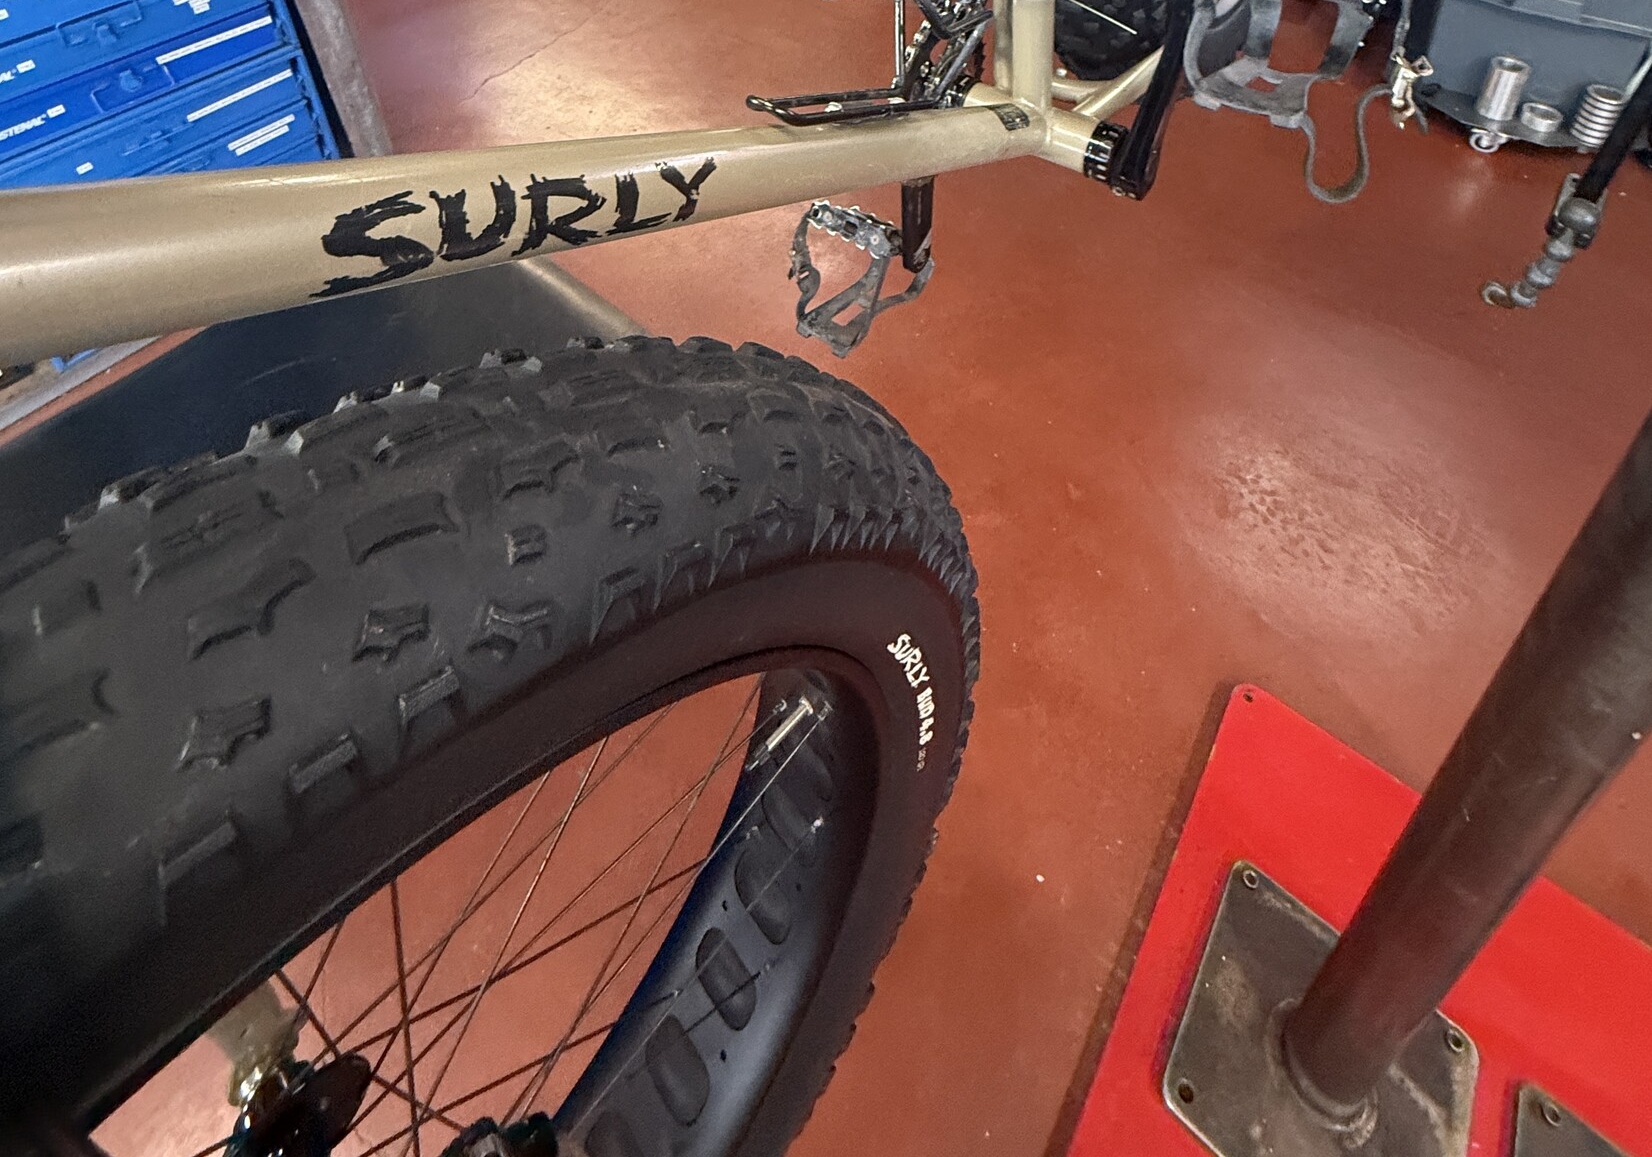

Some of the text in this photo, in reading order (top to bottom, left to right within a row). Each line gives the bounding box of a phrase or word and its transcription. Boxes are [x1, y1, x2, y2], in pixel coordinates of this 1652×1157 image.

[308, 155, 718, 299] SURLY
[886, 633, 930, 689] SURLY
[916, 686, 935, 719] BUD
